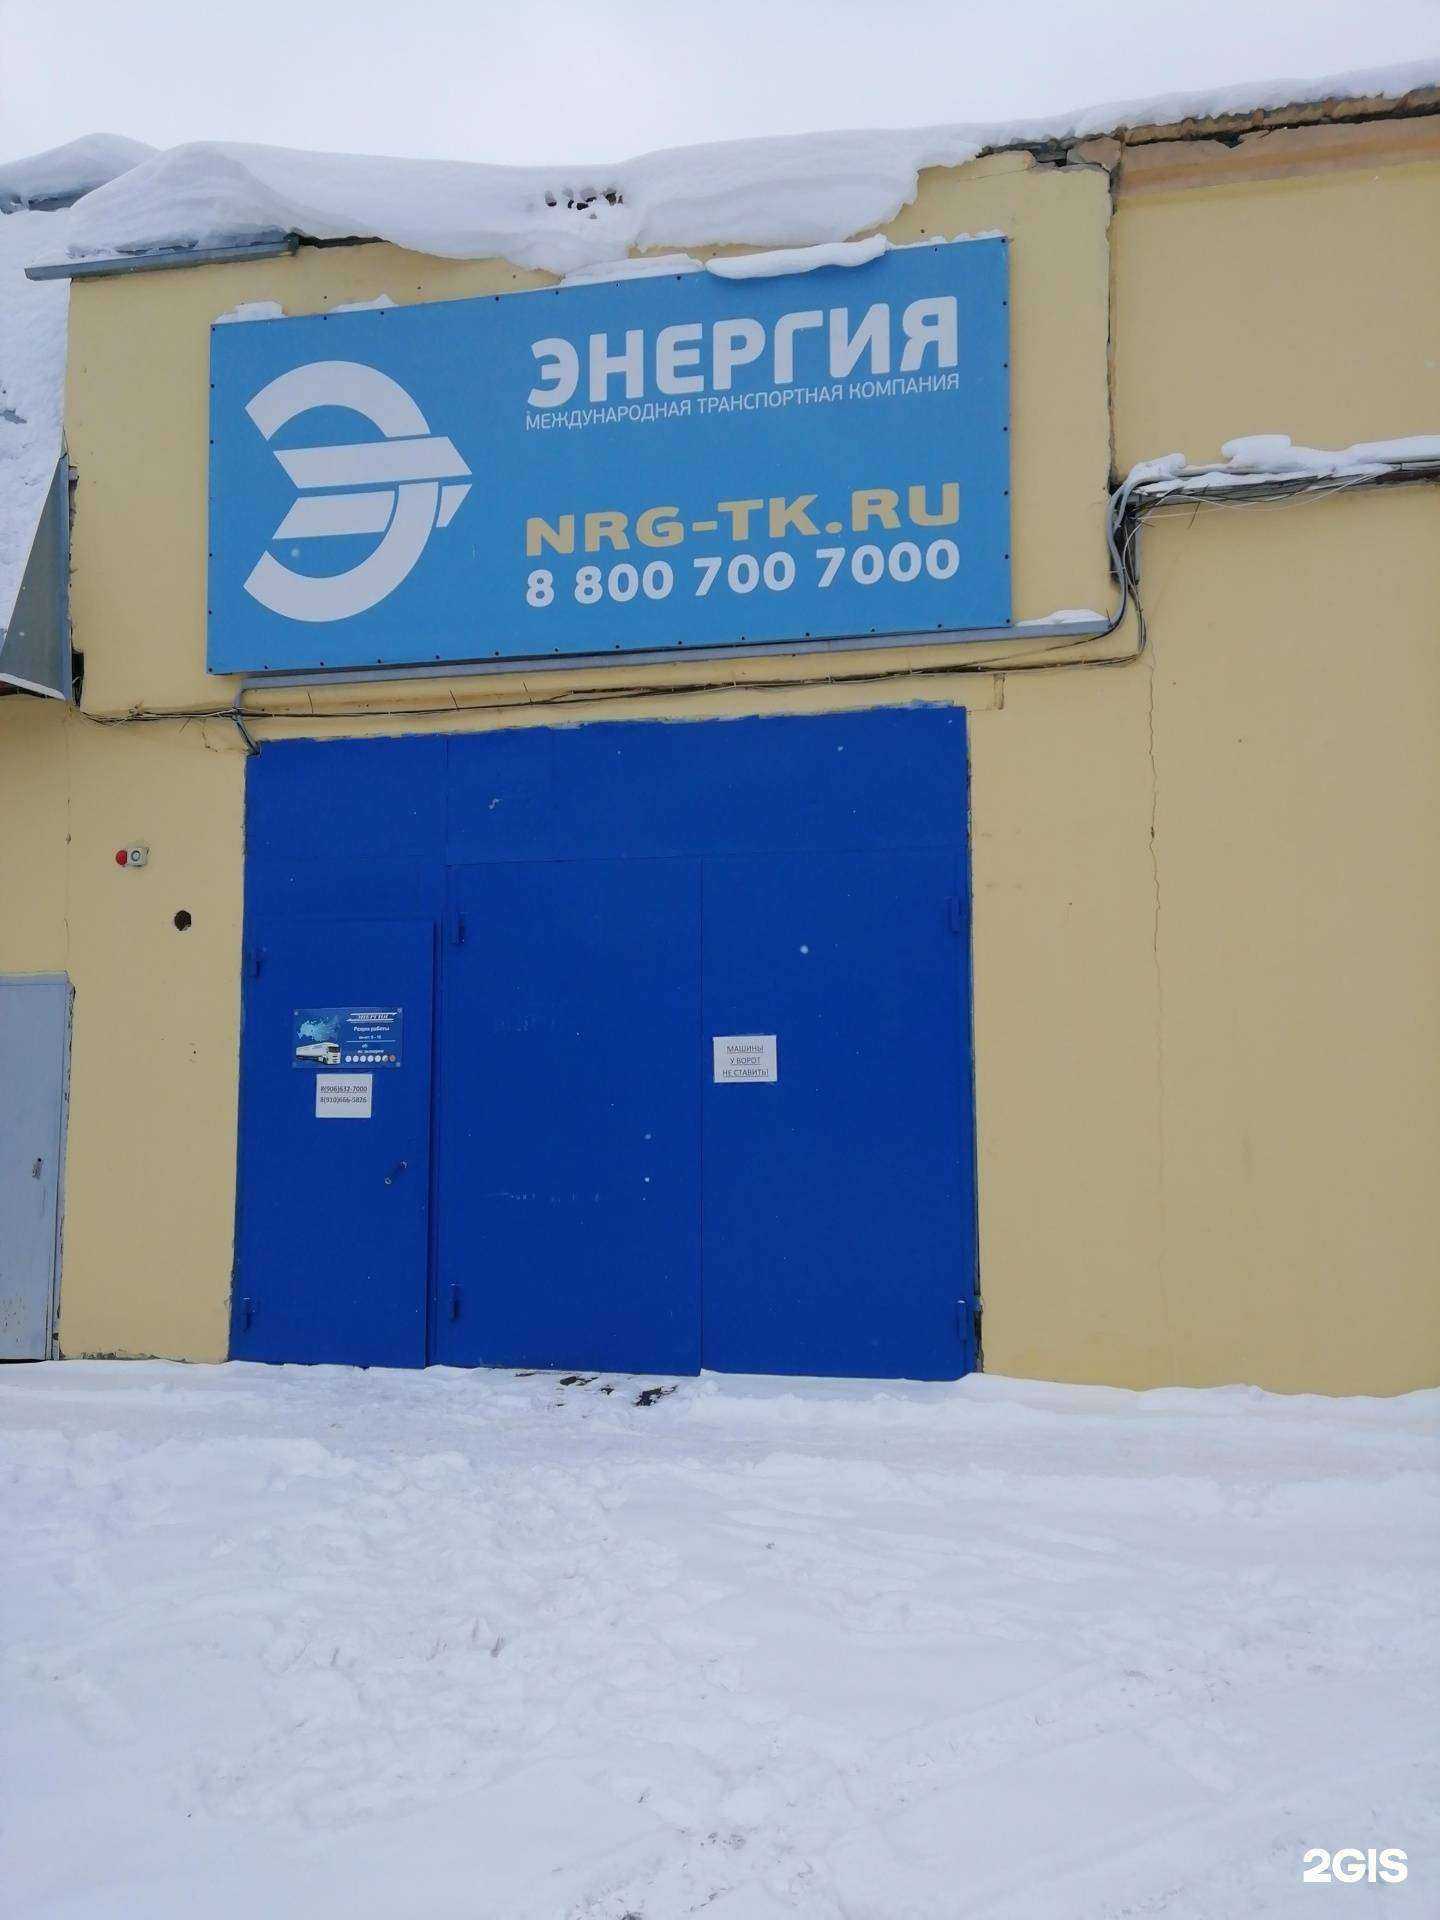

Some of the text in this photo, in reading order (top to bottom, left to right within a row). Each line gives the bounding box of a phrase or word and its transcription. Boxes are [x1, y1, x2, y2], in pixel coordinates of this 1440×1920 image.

[527, 296, 958, 408] ЭНЕРГИЯ
[526, 373, 960, 431] МЕЖДУНАРОДНАЯ ТРАНСПОРТНАЯ КОМПАНИЯ
[526, 482, 960, 557] NRG-TK.RU
[526, 538, 960, 608] 8 800 700 7000
[726, 1044, 764, 1053] МАШИНЫ
[736, 1056, 761, 1065] ВОРОТ
